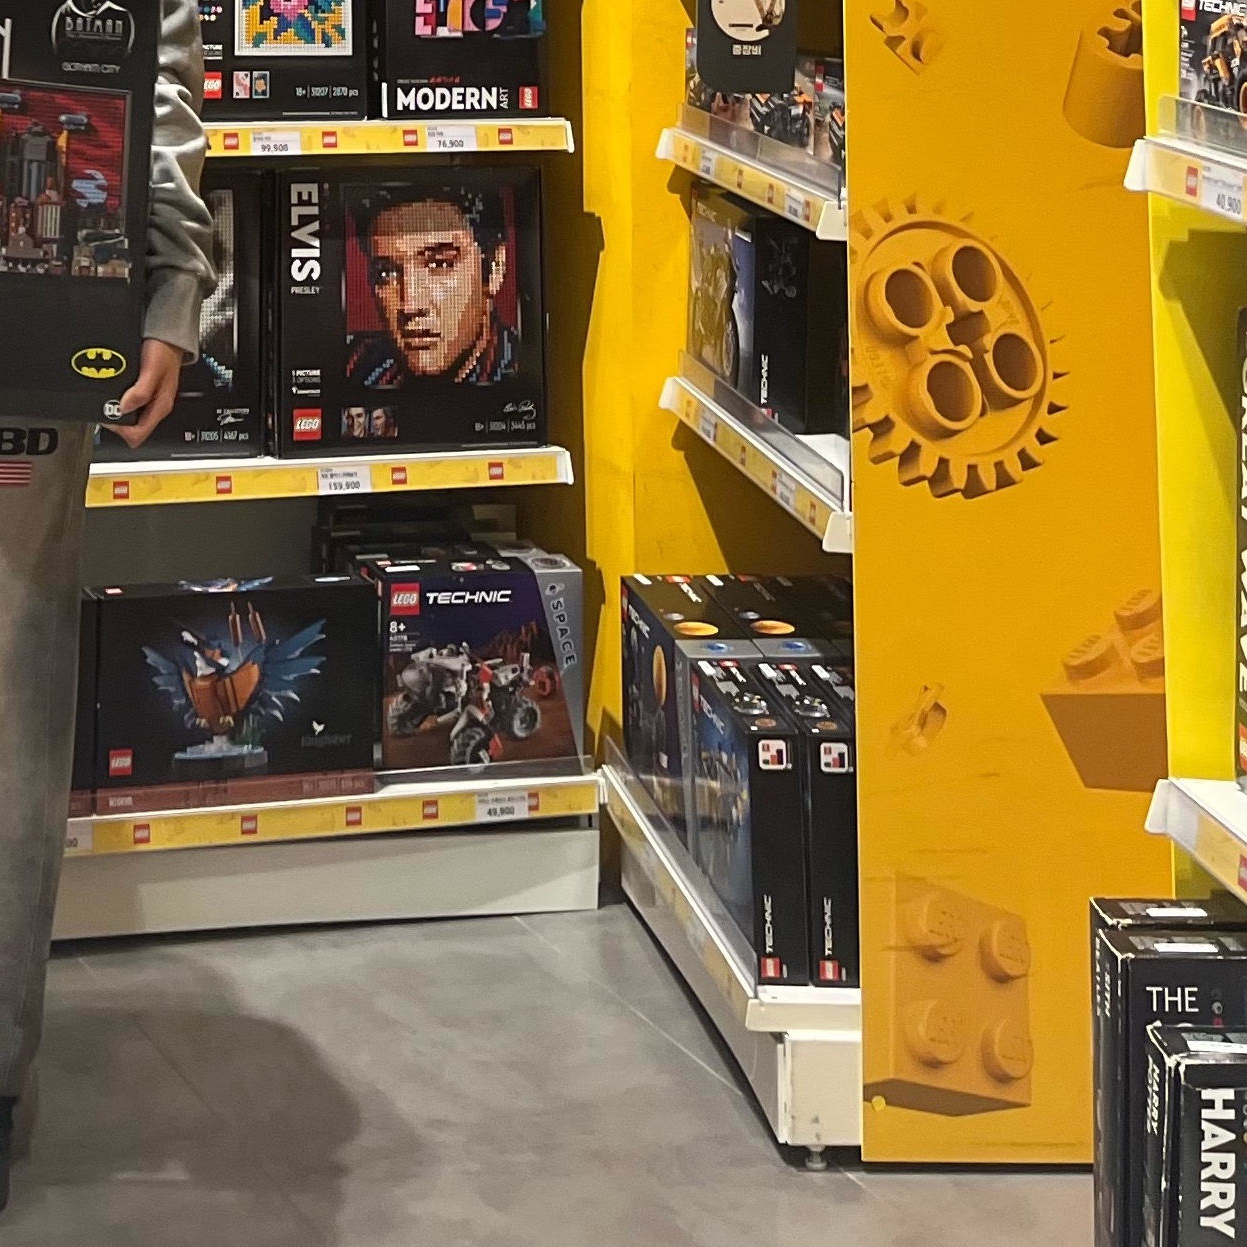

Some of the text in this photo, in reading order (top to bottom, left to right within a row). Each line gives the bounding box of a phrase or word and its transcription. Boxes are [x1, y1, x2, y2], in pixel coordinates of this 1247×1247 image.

[65, 16, 123, 34] BATMAN
[396, 86, 510, 119] MODERN ART
[290, 182, 321, 282] ELVIS
[290, 287, 321, 296] PRESLEY
[761, 354, 769, 405] TECHNIC
[295, 418, 320, 431] LEGO
[393, 594, 417, 611] LEGO
[426, 589, 512, 606] TECHNIC
[389, 621, 406, 634] 8+
[549, 599, 578, 667] SPACE
[763, 894, 774, 955] TECHNIC
[823, 897, 834, 957] TECHNIC
[1146, 986, 1200, 1013] THE
[1198, 1087, 1237, 1239] HARRY
